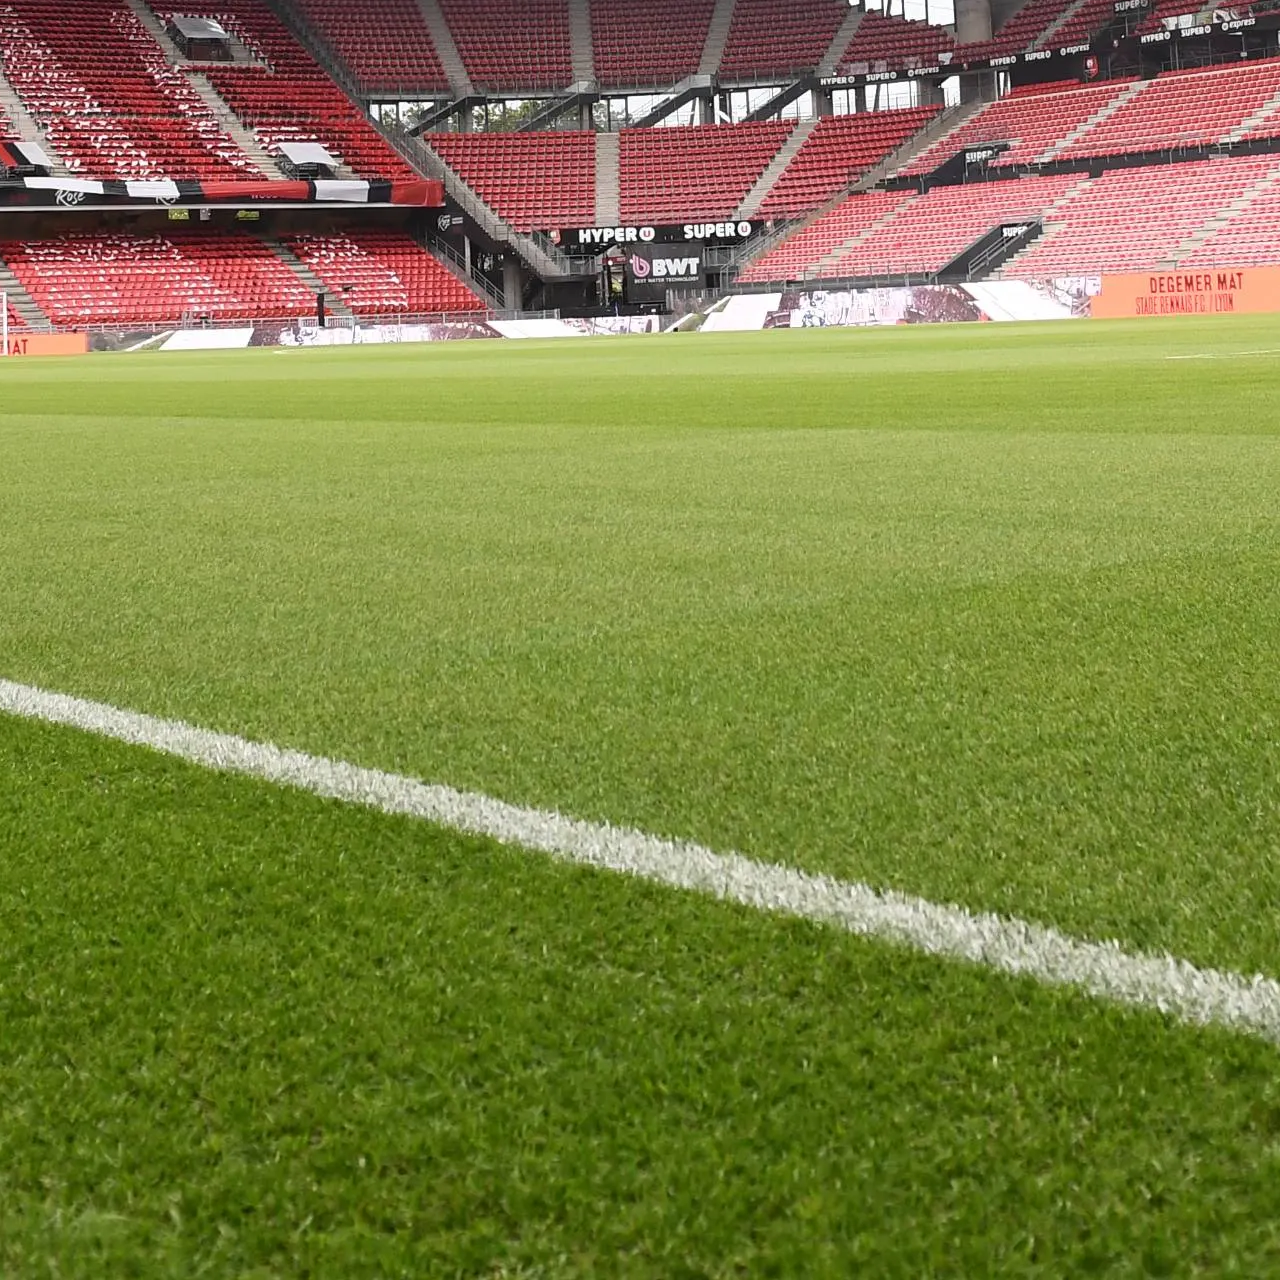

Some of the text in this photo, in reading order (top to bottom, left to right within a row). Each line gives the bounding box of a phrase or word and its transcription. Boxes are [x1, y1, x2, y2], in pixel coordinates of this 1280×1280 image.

[1114, 1, 1141, 12] SUPER
[1141, 18, 1255, 43] HYPER SUPER express
[990, 44, 1090, 67] HYPER SUPER express
[820, 77, 847, 86] HYPER
[866, 72, 889, 81] SUPER
[579, 227, 637, 243] HYPER
[684, 223, 735, 239] SUPER
[652, 257, 699, 276] BWT
[1150, 272, 1243, 293] DEGEMER MAT
[1136, 296, 1158, 314] STADE
[1160, 294, 1193, 313] RENNAIS
[1215, 293, 1234, 312] LYON
